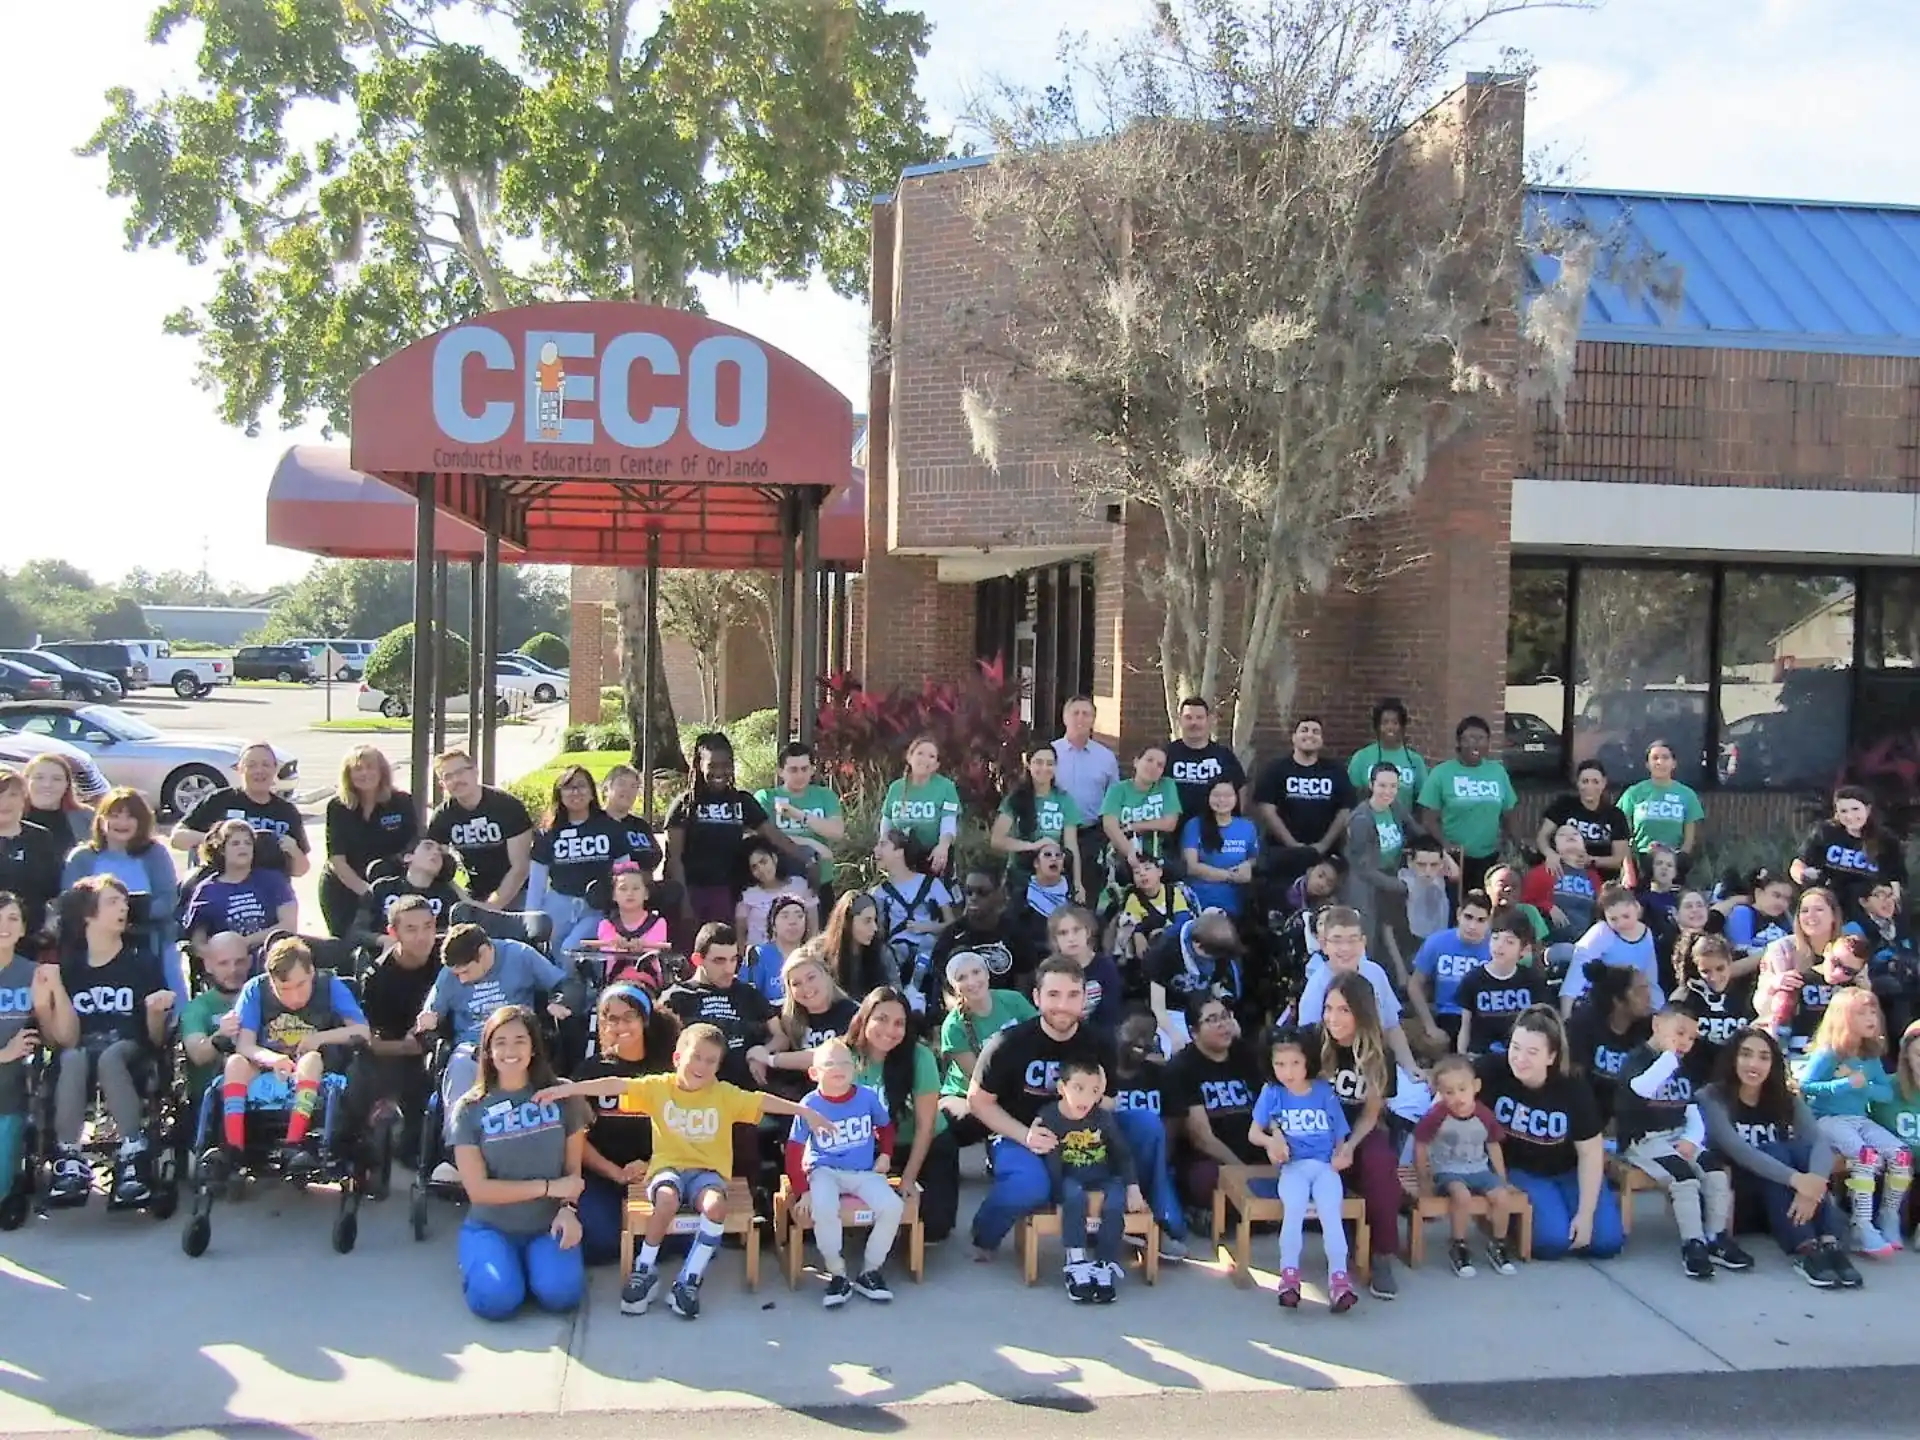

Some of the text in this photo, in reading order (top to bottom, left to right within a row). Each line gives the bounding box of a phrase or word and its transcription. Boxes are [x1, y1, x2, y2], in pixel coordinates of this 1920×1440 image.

[433, 326, 768, 451] CECO
[433, 448, 769, 477] Conductive Education Center Of Orlando
[1286, 777, 1332, 795] CECO
[1454, 778, 1499, 796] CECO
[891, 800, 935, 818] CECO
[451, 823, 501, 844] CECO
[627, 831, 650, 847] CO
[554, 834, 609, 858] CECO
[1438, 954, 1488, 976] CEC
[0, 987, 32, 1013] CO
[1477, 988, 1532, 1011] CECO
[1115, 1090, 1161, 1113] ECO
[1200, 1080, 1253, 1109] CEC
[481, 1099, 561, 1136] CECO
[662, 1100, 720, 1135] CECO
[1494, 1096, 1568, 1138] CECO
